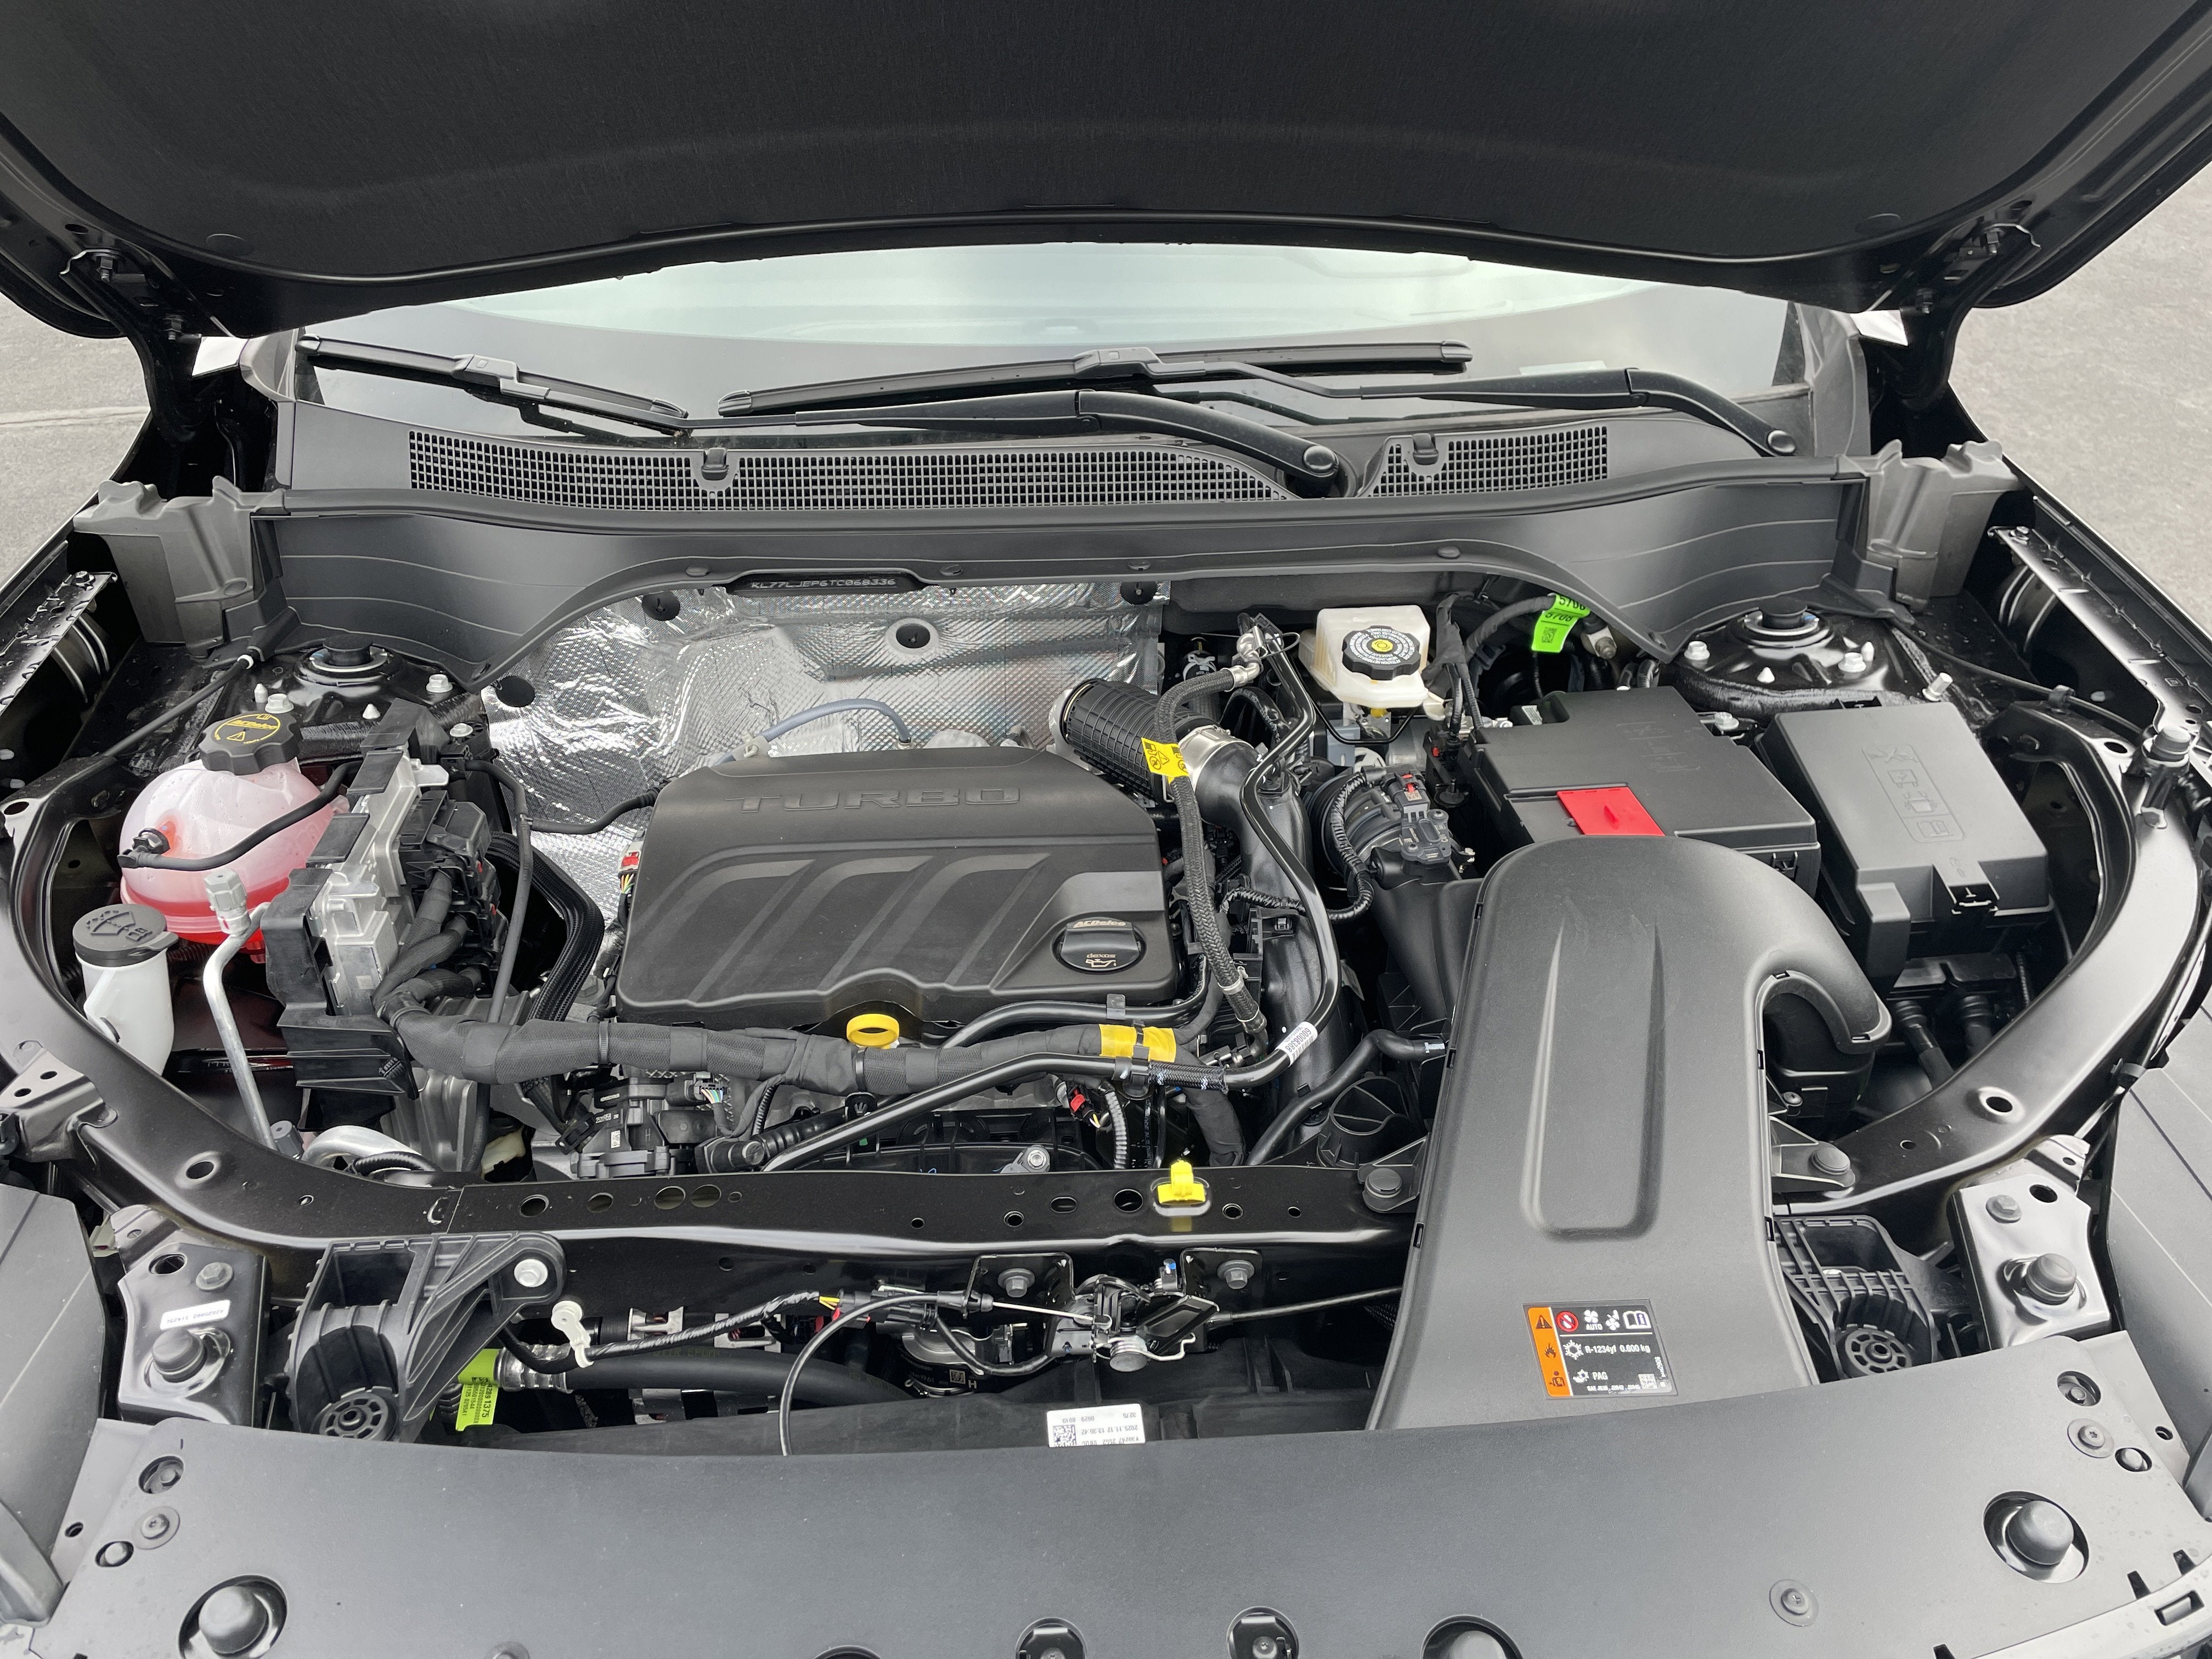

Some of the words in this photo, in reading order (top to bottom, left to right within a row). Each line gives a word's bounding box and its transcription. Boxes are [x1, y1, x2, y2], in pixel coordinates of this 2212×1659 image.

[751, 578, 896, 589] KL77LJEP6TC068336
[724, 788, 1020, 813] TURBO
[1073, 920, 1126, 928] ACDelco
[1592, 1371, 1609, 1380] PAG
[482, 1401, 492, 1418] 1375
